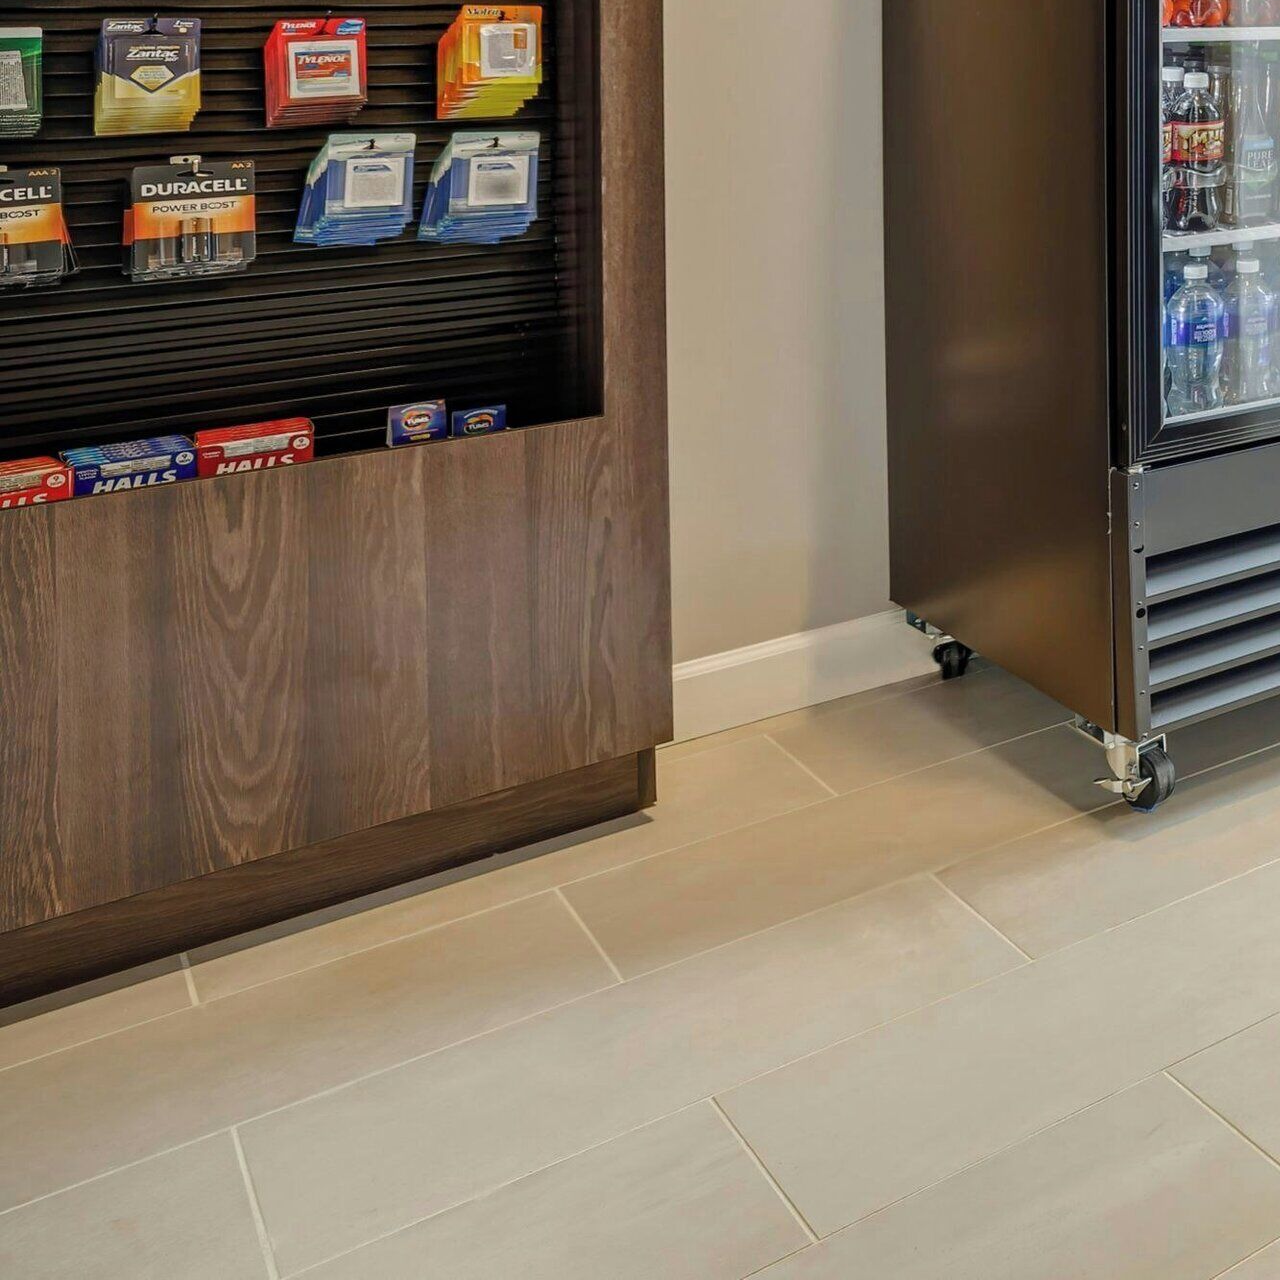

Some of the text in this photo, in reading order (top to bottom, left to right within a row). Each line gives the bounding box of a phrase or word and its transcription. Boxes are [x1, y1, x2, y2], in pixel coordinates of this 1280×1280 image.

[107, 22, 144, 31] Zantac
[127, 48, 179, 59] Zantac
[297, 55, 348, 65] TYLENOL
[1248, 151, 1274, 159] PURE
[0, 186, 52, 201] CELL
[141, 178, 247, 197] DURACELL
[152, 201, 237, 213] POWER BOOST
[216, 454, 294, 475] HALLS
[92, 470, 177, 494] HALLS
